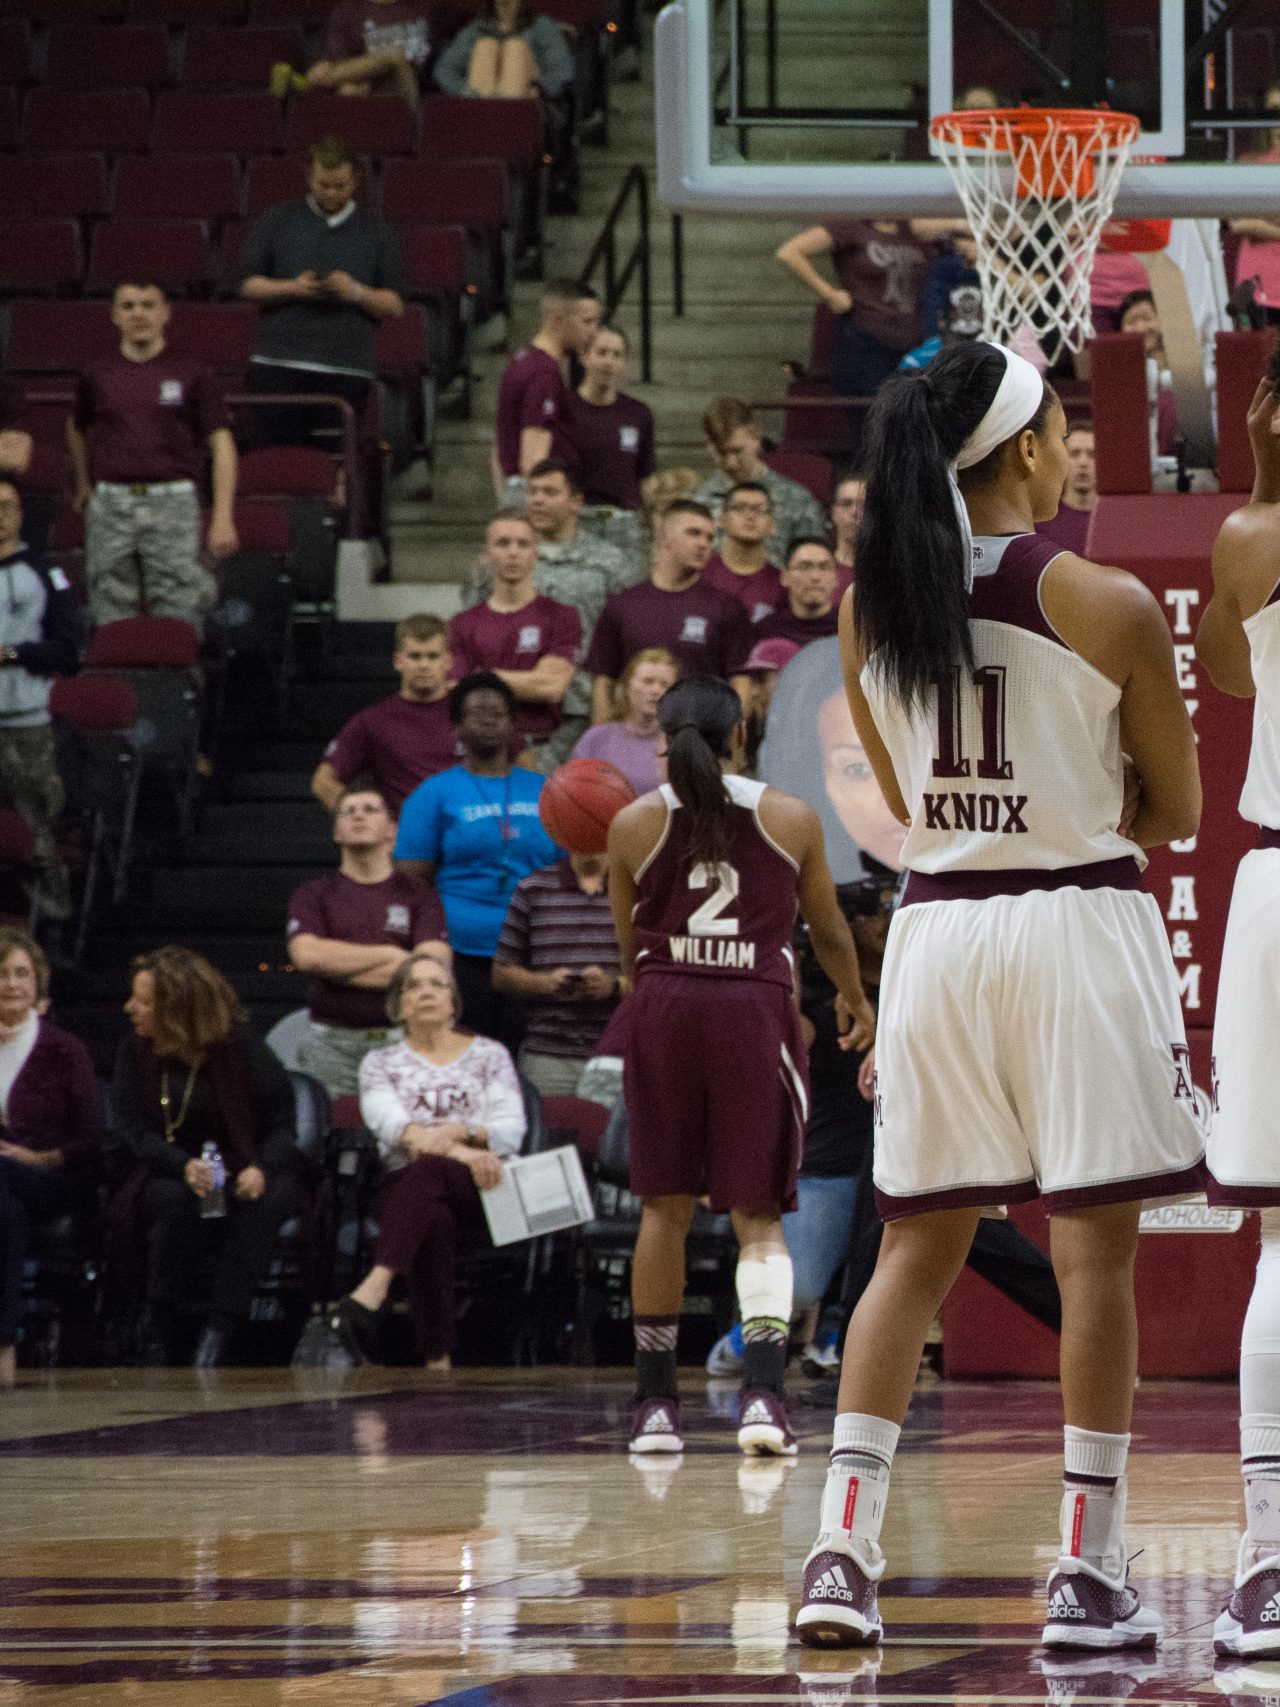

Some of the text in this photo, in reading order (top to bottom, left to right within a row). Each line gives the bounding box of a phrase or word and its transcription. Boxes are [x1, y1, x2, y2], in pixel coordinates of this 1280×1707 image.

[930, 665, 1014, 779] 11
[923, 793, 1028, 833] KNOX
[687, 861, 739, 936] 2
[669, 936, 755, 969] WILLIAM
[809, 1585, 853, 1601] adidas
